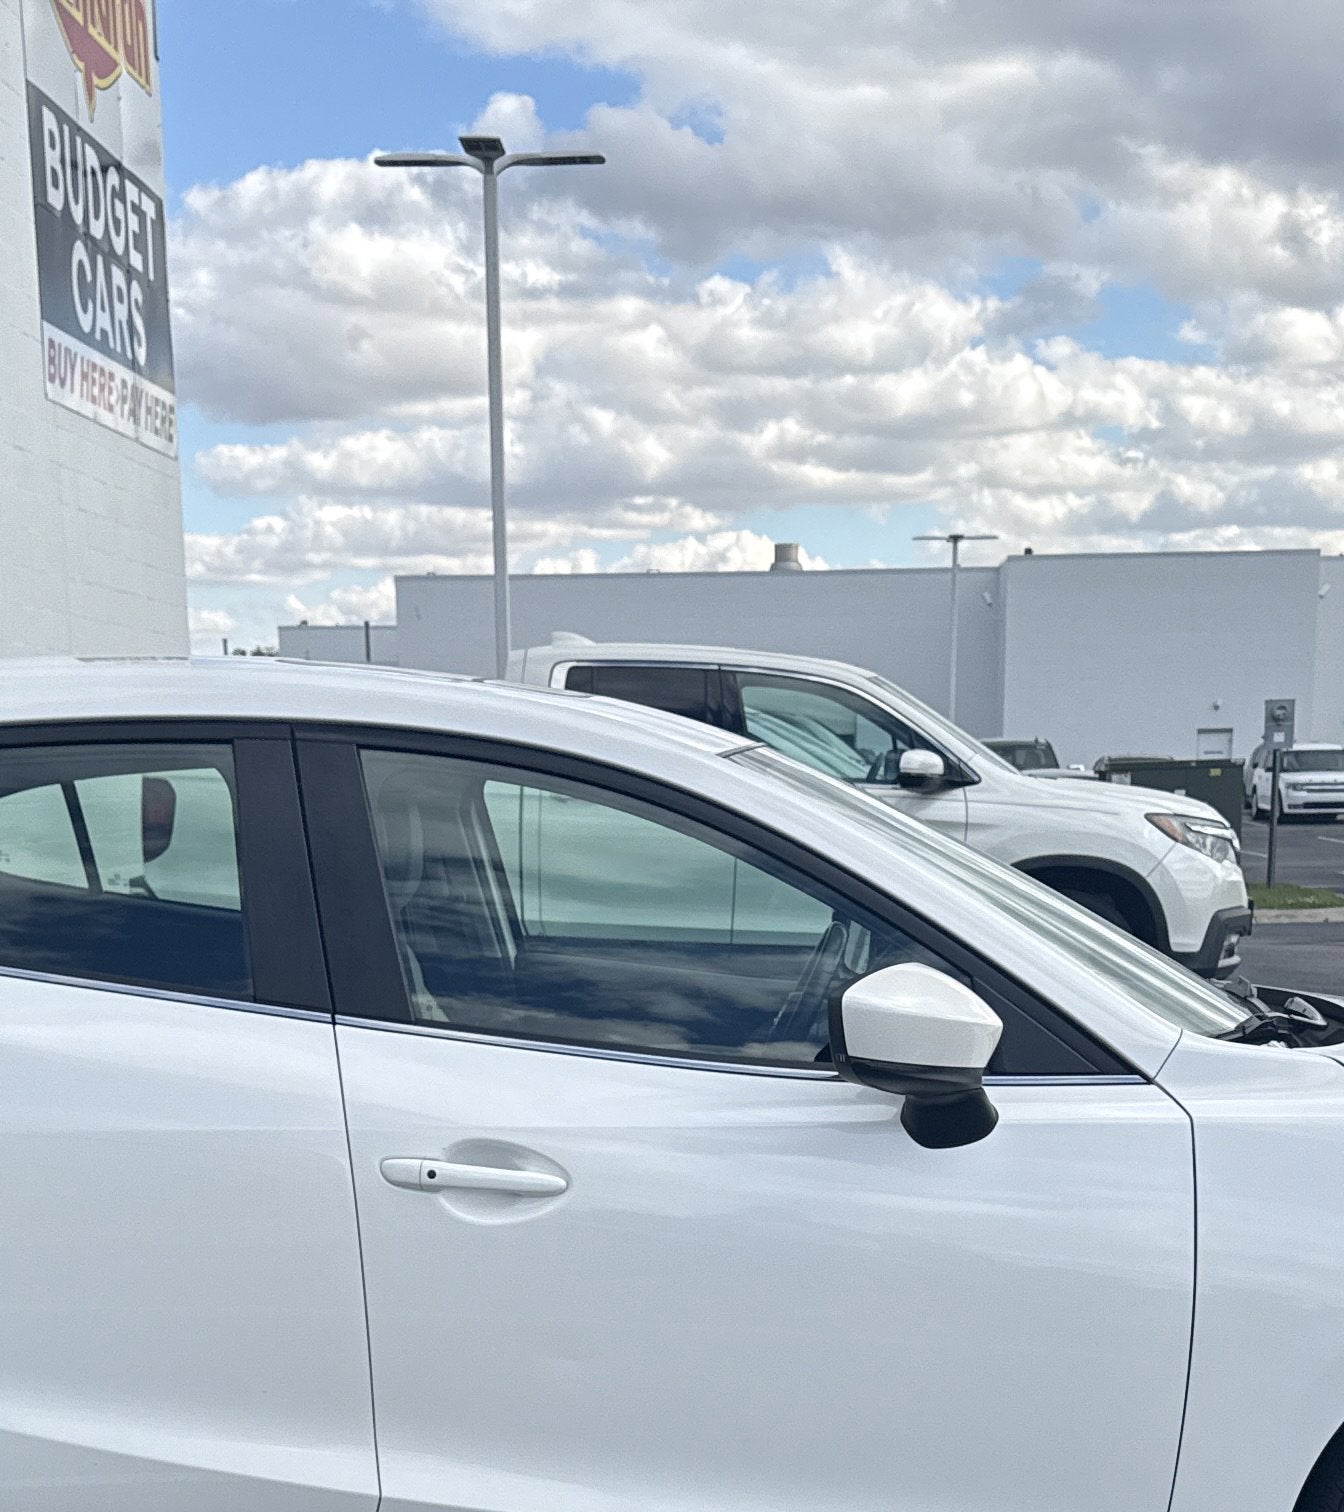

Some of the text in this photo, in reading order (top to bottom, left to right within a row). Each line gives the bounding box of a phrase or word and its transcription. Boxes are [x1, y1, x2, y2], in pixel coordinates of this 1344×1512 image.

[41, 104, 156, 282] BUDGET
[71, 239, 147, 367] CARS
[48, 337, 174, 443] BUY HERE PAY HERE
